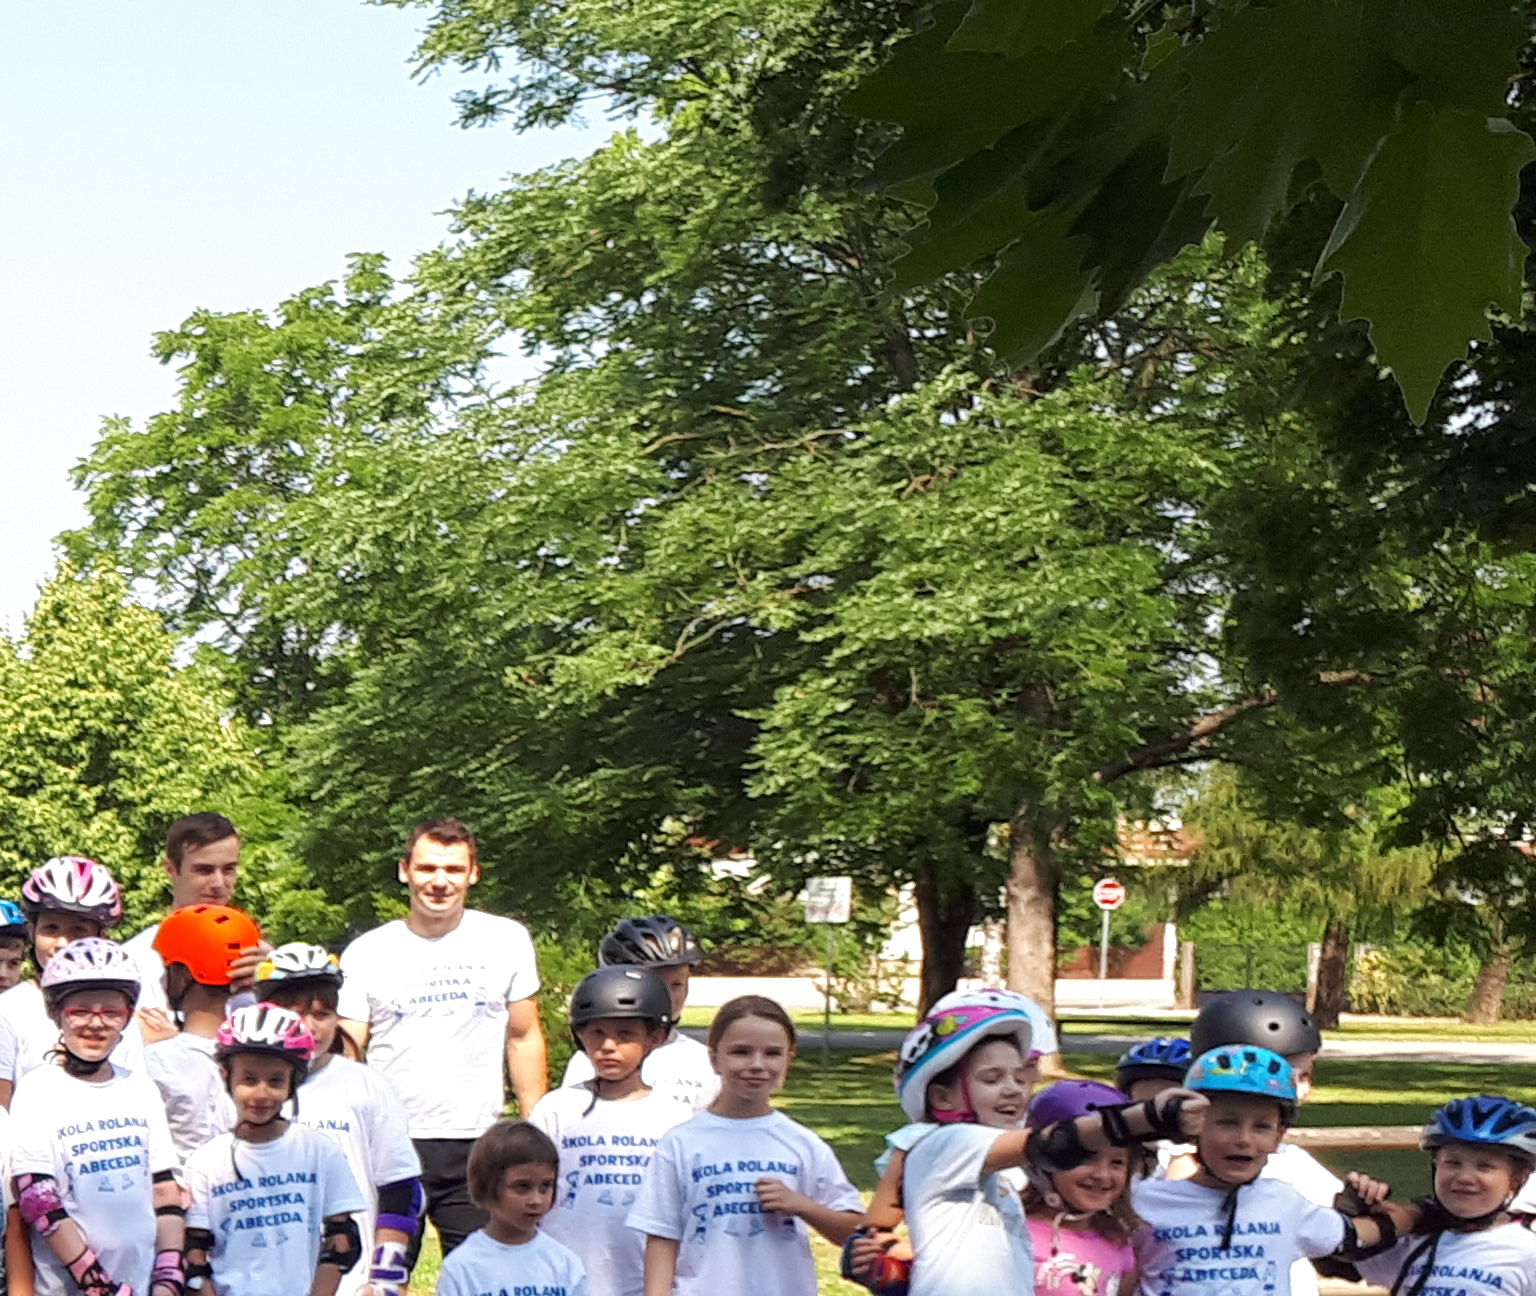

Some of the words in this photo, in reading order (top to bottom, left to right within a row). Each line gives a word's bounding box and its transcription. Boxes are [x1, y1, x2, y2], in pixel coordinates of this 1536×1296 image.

[71, 1135, 142, 1156] SPORTSKA
[612, 1135, 659, 1147] ROLAN
[79, 1155, 141, 1175] ABECEDA
[584, 1174, 641, 1185] ABECED
[229, 1193, 305, 1213] SPORTSKA
[234, 1212, 303, 1231] ABECEDA
[1181, 1267, 1260, 1282] ABECEDA
